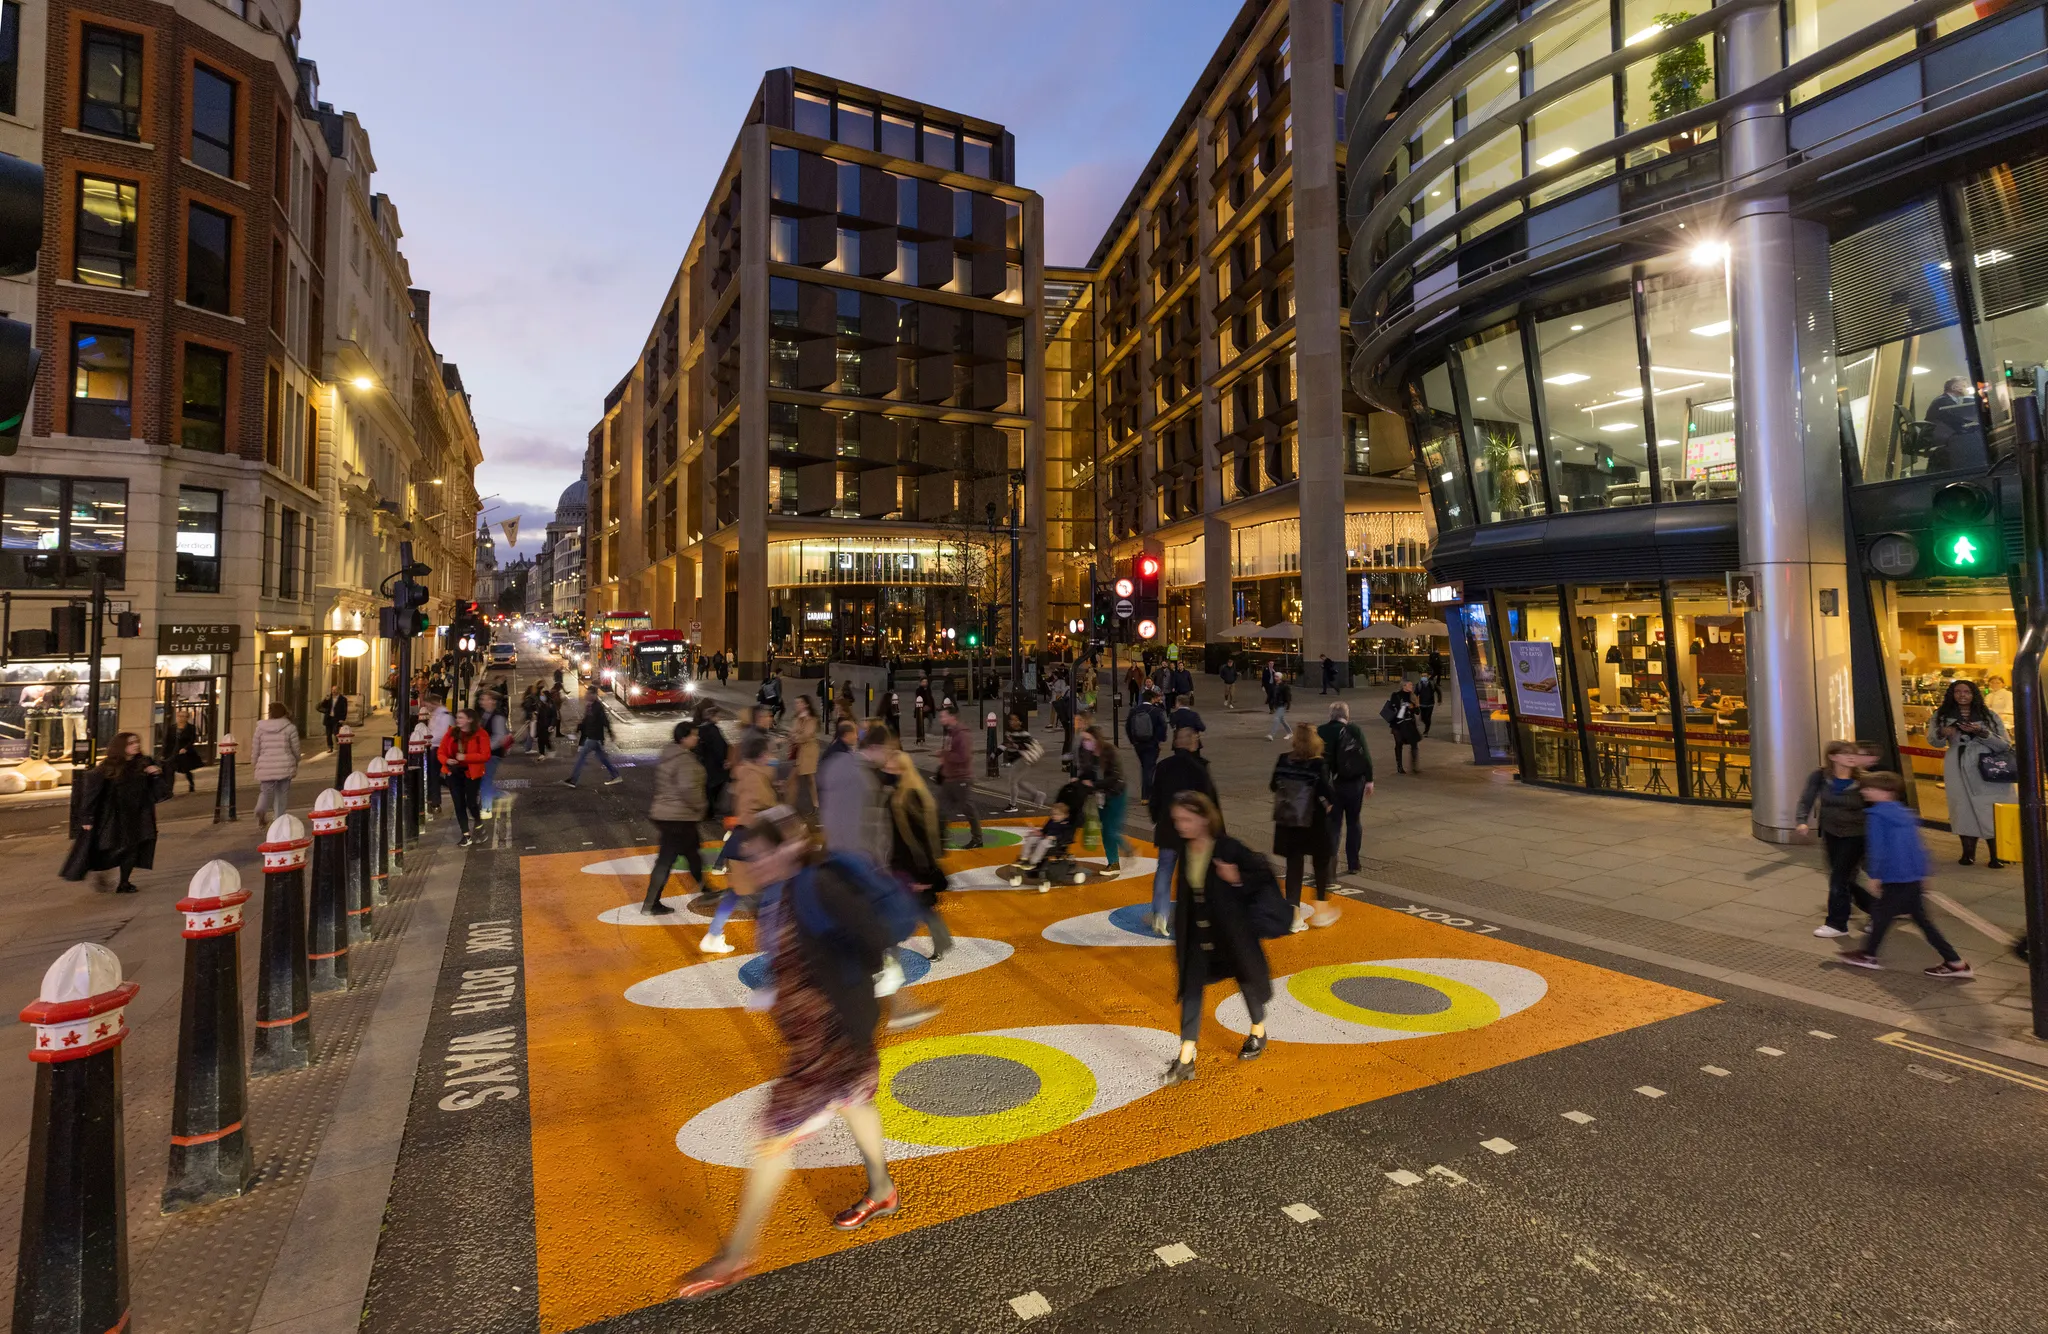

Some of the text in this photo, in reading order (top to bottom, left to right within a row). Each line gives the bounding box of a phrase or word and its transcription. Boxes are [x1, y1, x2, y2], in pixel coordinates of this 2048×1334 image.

[172, 626, 230, 634] HAWES
[197, 634, 206, 642] &
[169, 643, 231, 652] CURTIS
[672, 644, 683, 653] 521
[1392, 904, 1501, 934] LOOK
[438, 920, 520, 1111] LOOK BOTH WAYS
